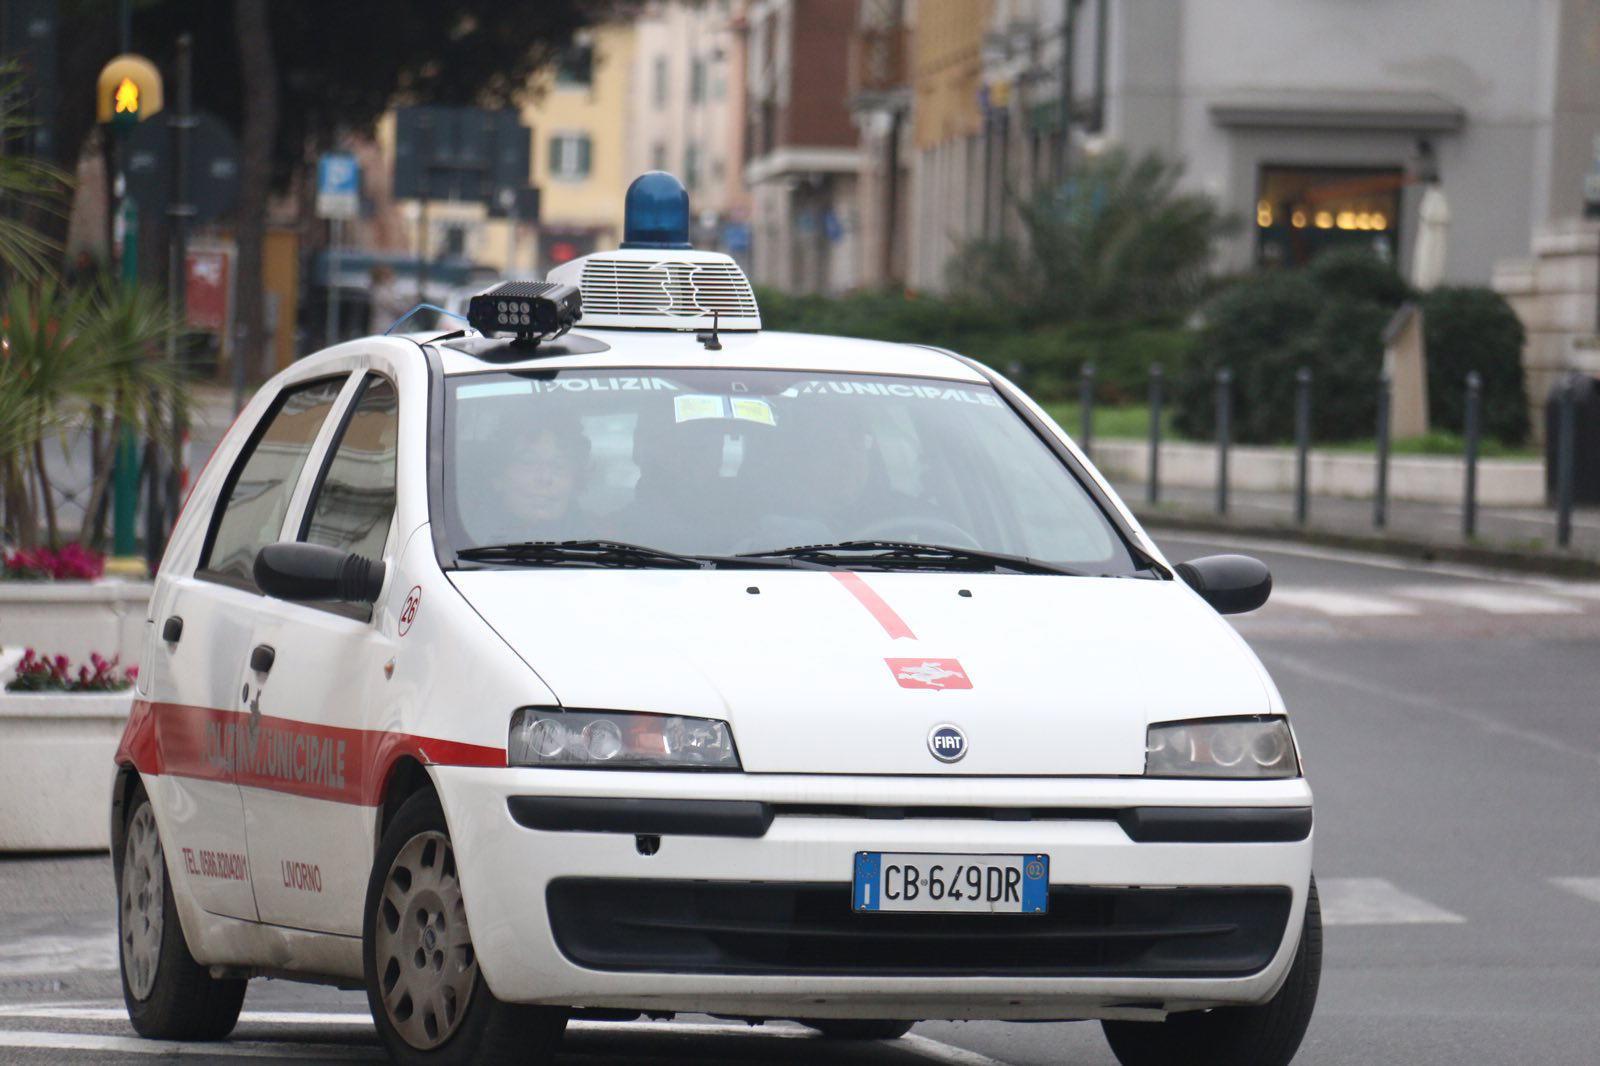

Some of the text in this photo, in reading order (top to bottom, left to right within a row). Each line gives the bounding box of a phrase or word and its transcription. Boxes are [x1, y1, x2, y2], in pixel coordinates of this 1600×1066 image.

[402, 596, 418, 624] 26
[934, 736, 961, 749] FIAT
[182, 848, 200, 875] TEL.
[281, 860, 322, 892] LIVORNO
